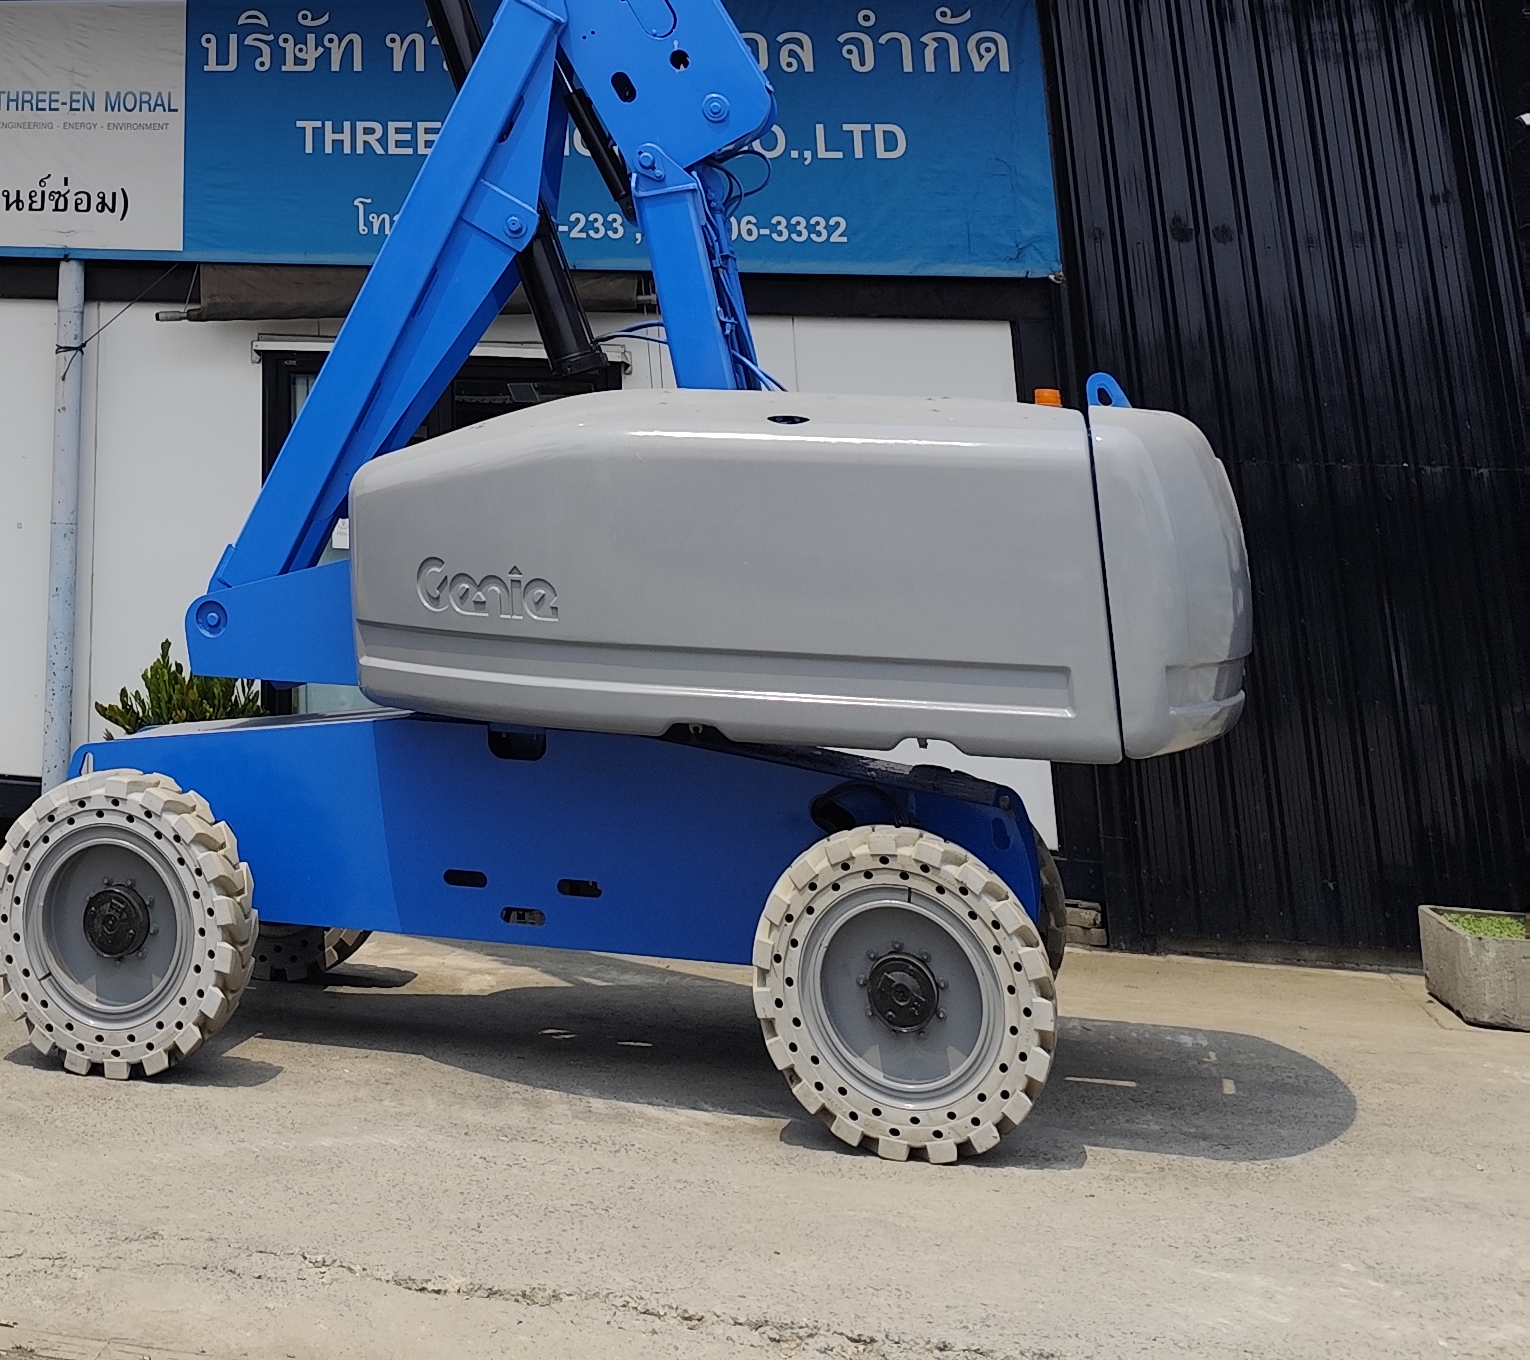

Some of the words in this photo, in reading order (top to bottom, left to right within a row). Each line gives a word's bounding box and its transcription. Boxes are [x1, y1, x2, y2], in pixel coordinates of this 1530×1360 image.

[200, 9, 363, 72] บริษัท
[836, 6, 1010, 73] จำกัด
[104, 91, 179, 113] MORAL
[63, 122, 98, 130] ENERGY
[107, 122, 170, 131] ENVIRONMENT
[416, 556, 559, 622] Genie
